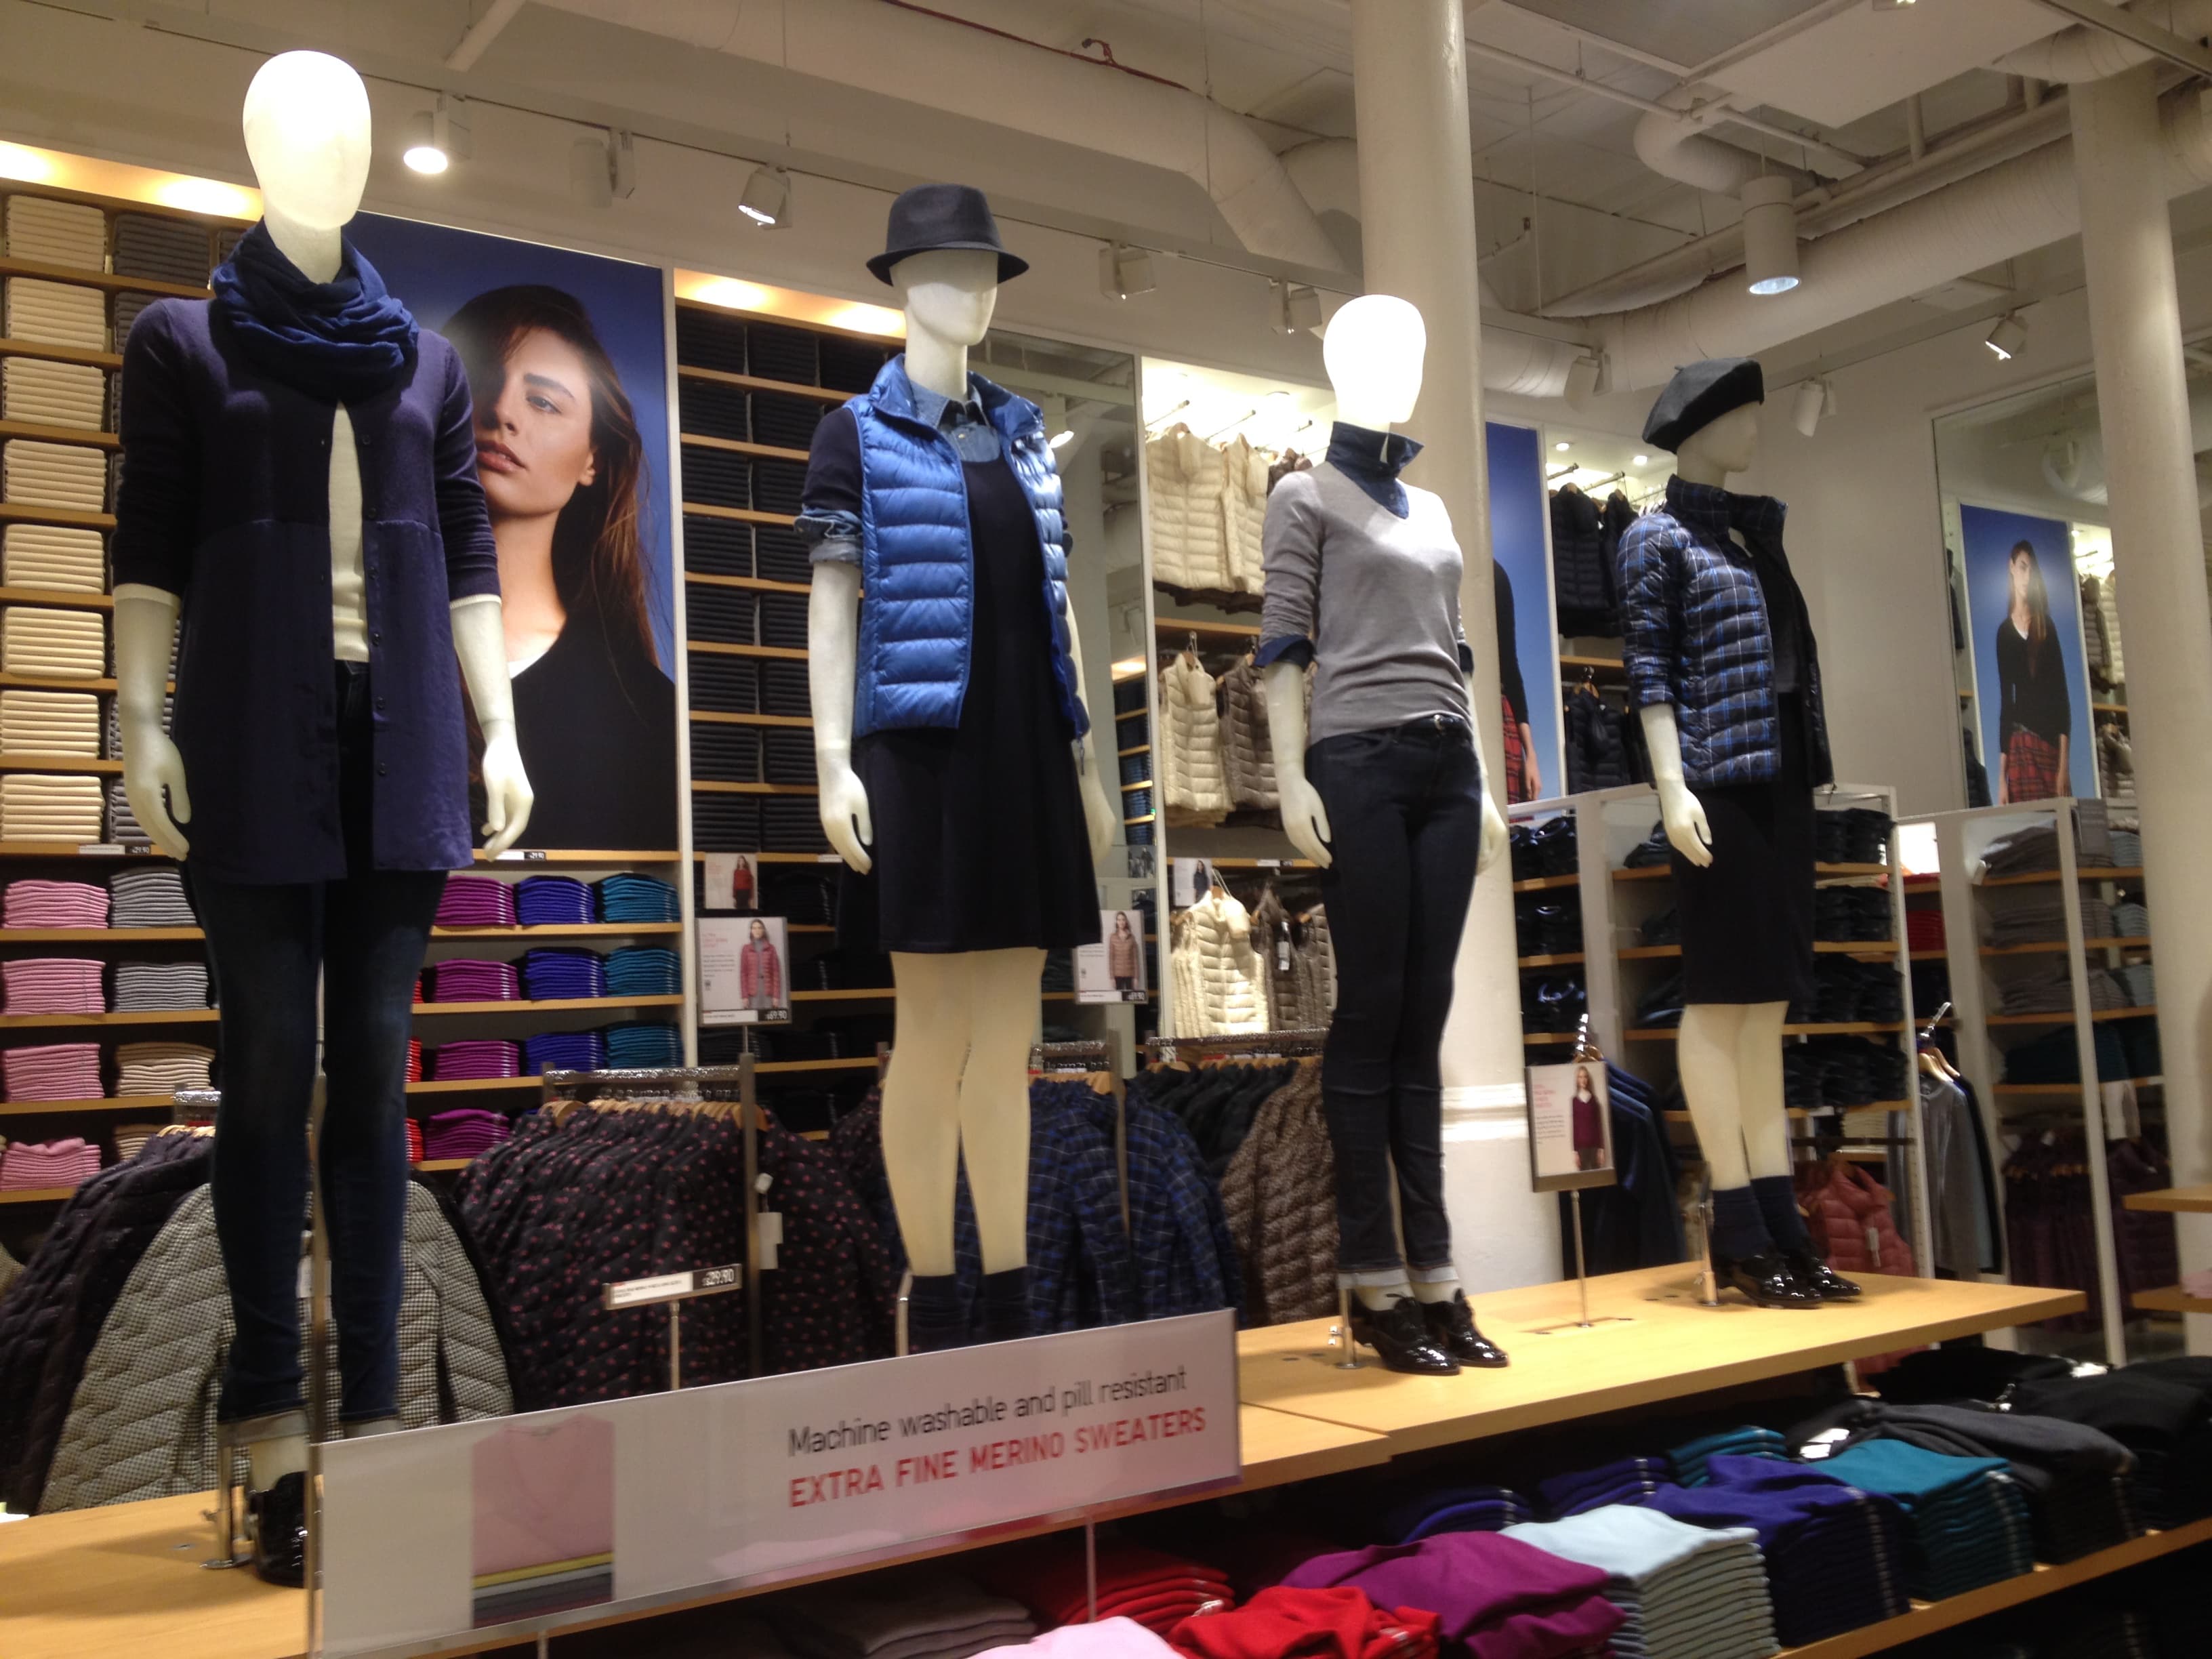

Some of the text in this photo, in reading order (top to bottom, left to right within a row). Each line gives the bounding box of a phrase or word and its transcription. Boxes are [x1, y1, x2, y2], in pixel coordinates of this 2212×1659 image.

[787, 1365, 1187, 1456] Machine washable and pill resistant
[788, 1406, 1206, 1508] EXTRA FINE MERINO SWEATERS
